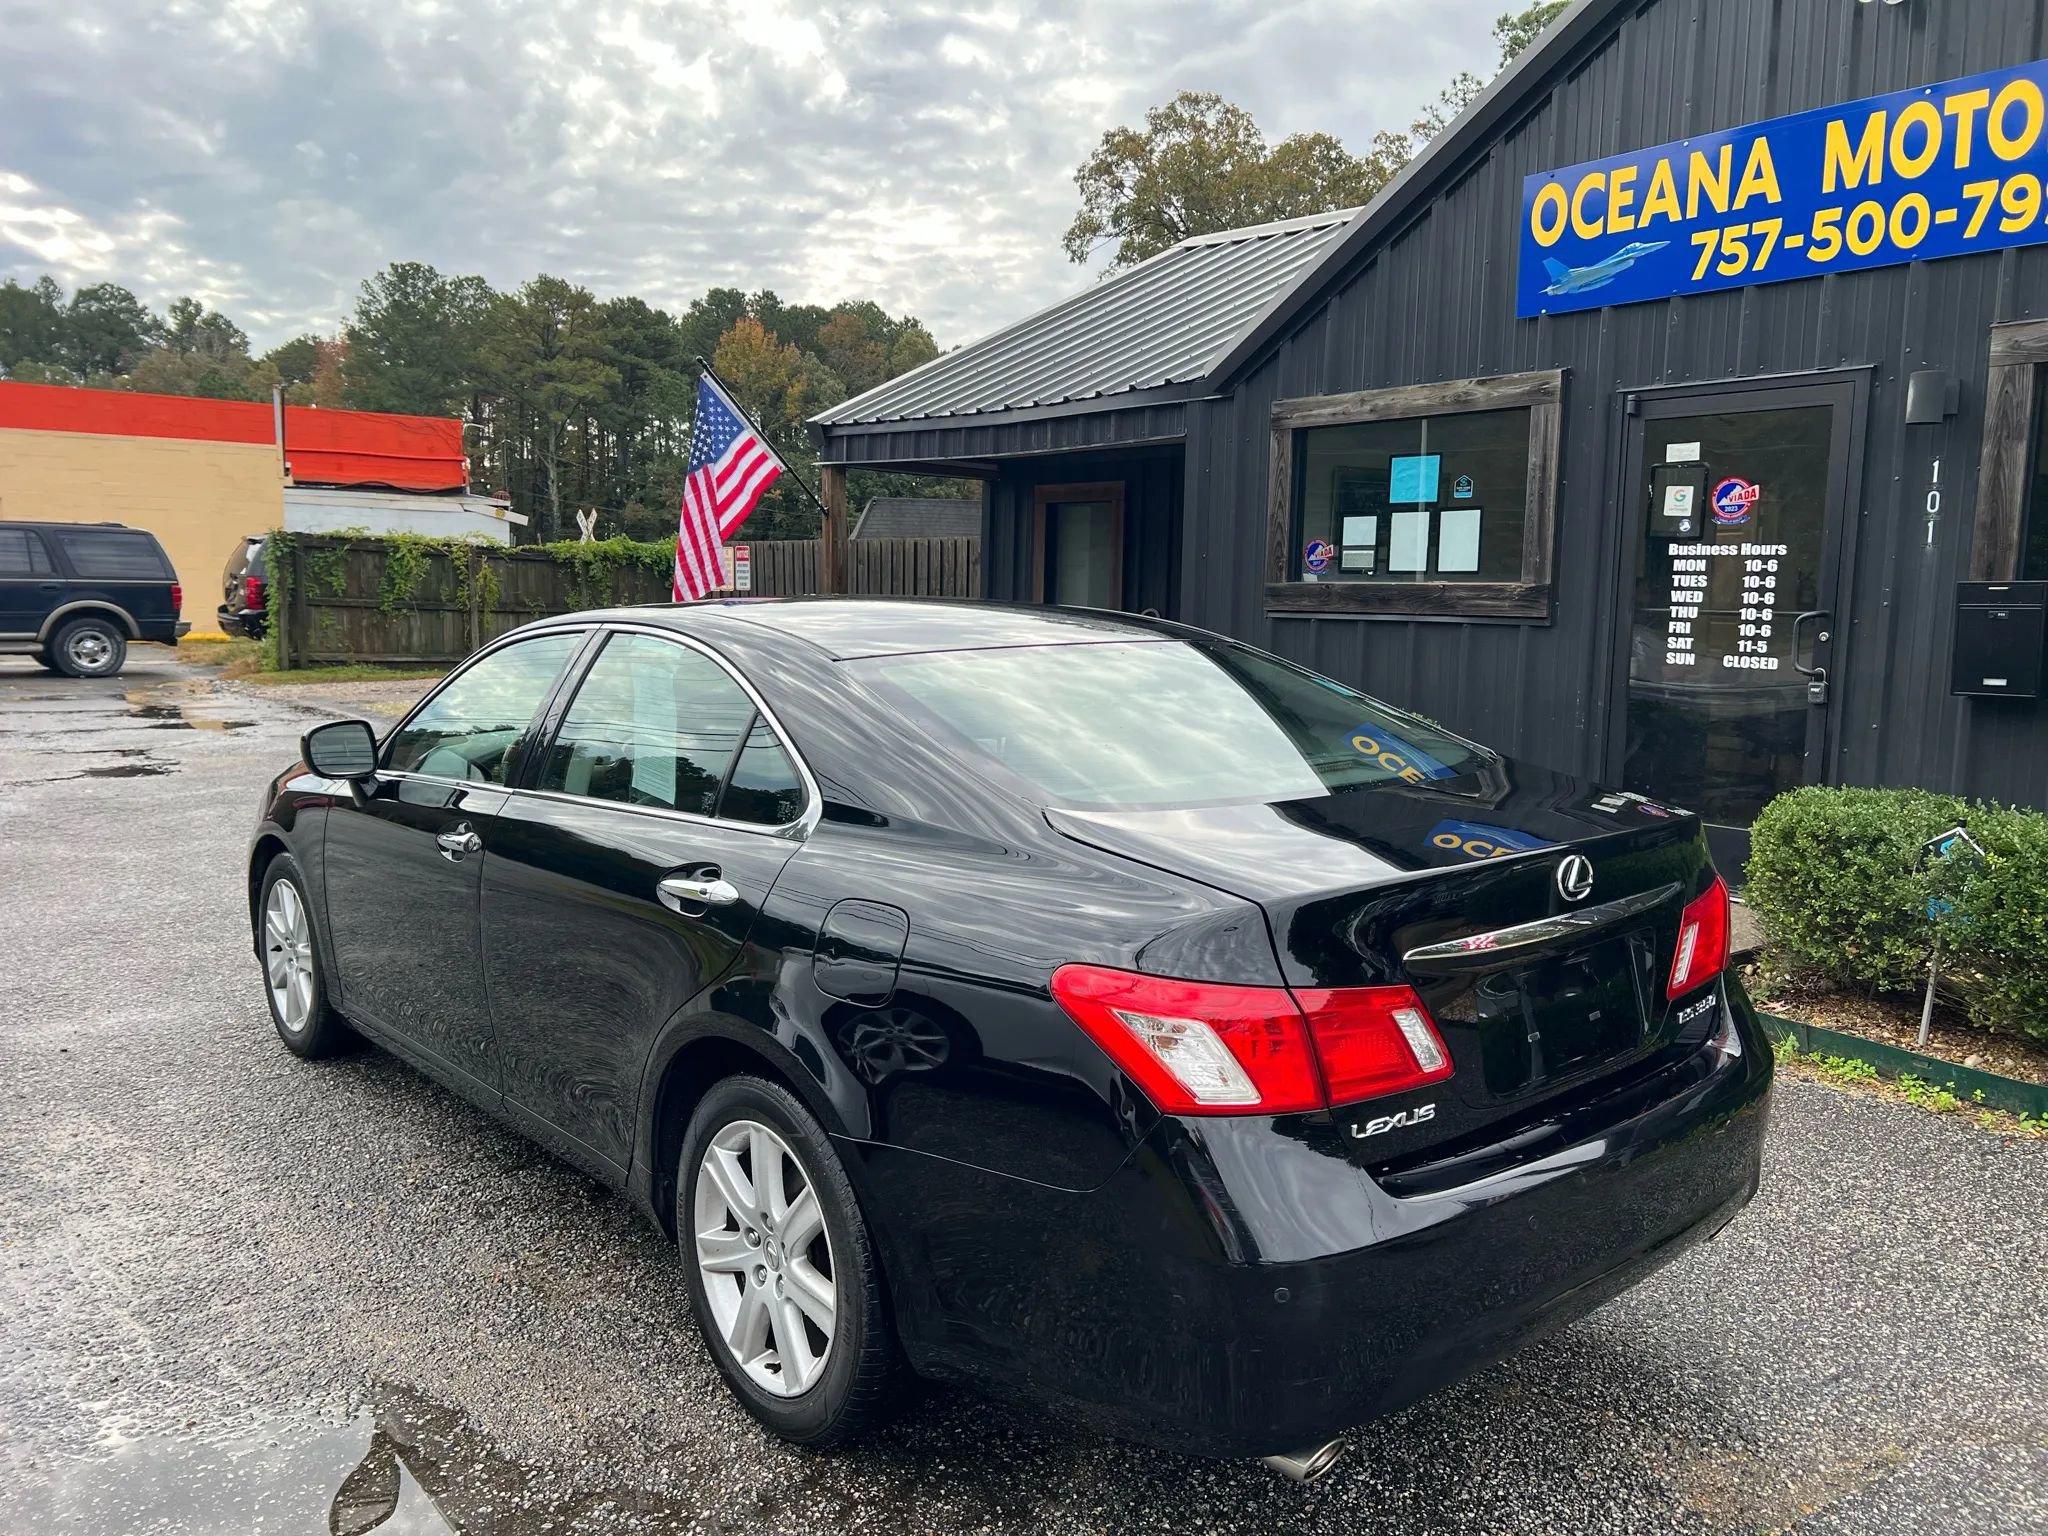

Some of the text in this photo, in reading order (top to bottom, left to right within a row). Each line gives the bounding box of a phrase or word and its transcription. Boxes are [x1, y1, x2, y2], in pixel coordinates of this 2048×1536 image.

[1531, 79, 2048, 248] OCEANA MOTO
[1690, 173, 2048, 281] 757-500-79
[1728, 487, 1757, 503] VIADA
[1926, 459, 1941, 544] 101
[1668, 543, 1788, 556] Business Hours
[1673, 559, 1778, 572] MON 10-6
[1672, 575, 1776, 588] TUES 10-6
[1670, 590, 1775, 604] WED 10-6
[1669, 606, 1773, 621] THU 10-6
[1668, 622, 1772, 637] FRI 10-6
[1667, 637, 1768, 653] SAT 11-5
[1665, 653, 1779, 670] SUN CLOSED
[1351, 1102, 1436, 1139] LEXUS
